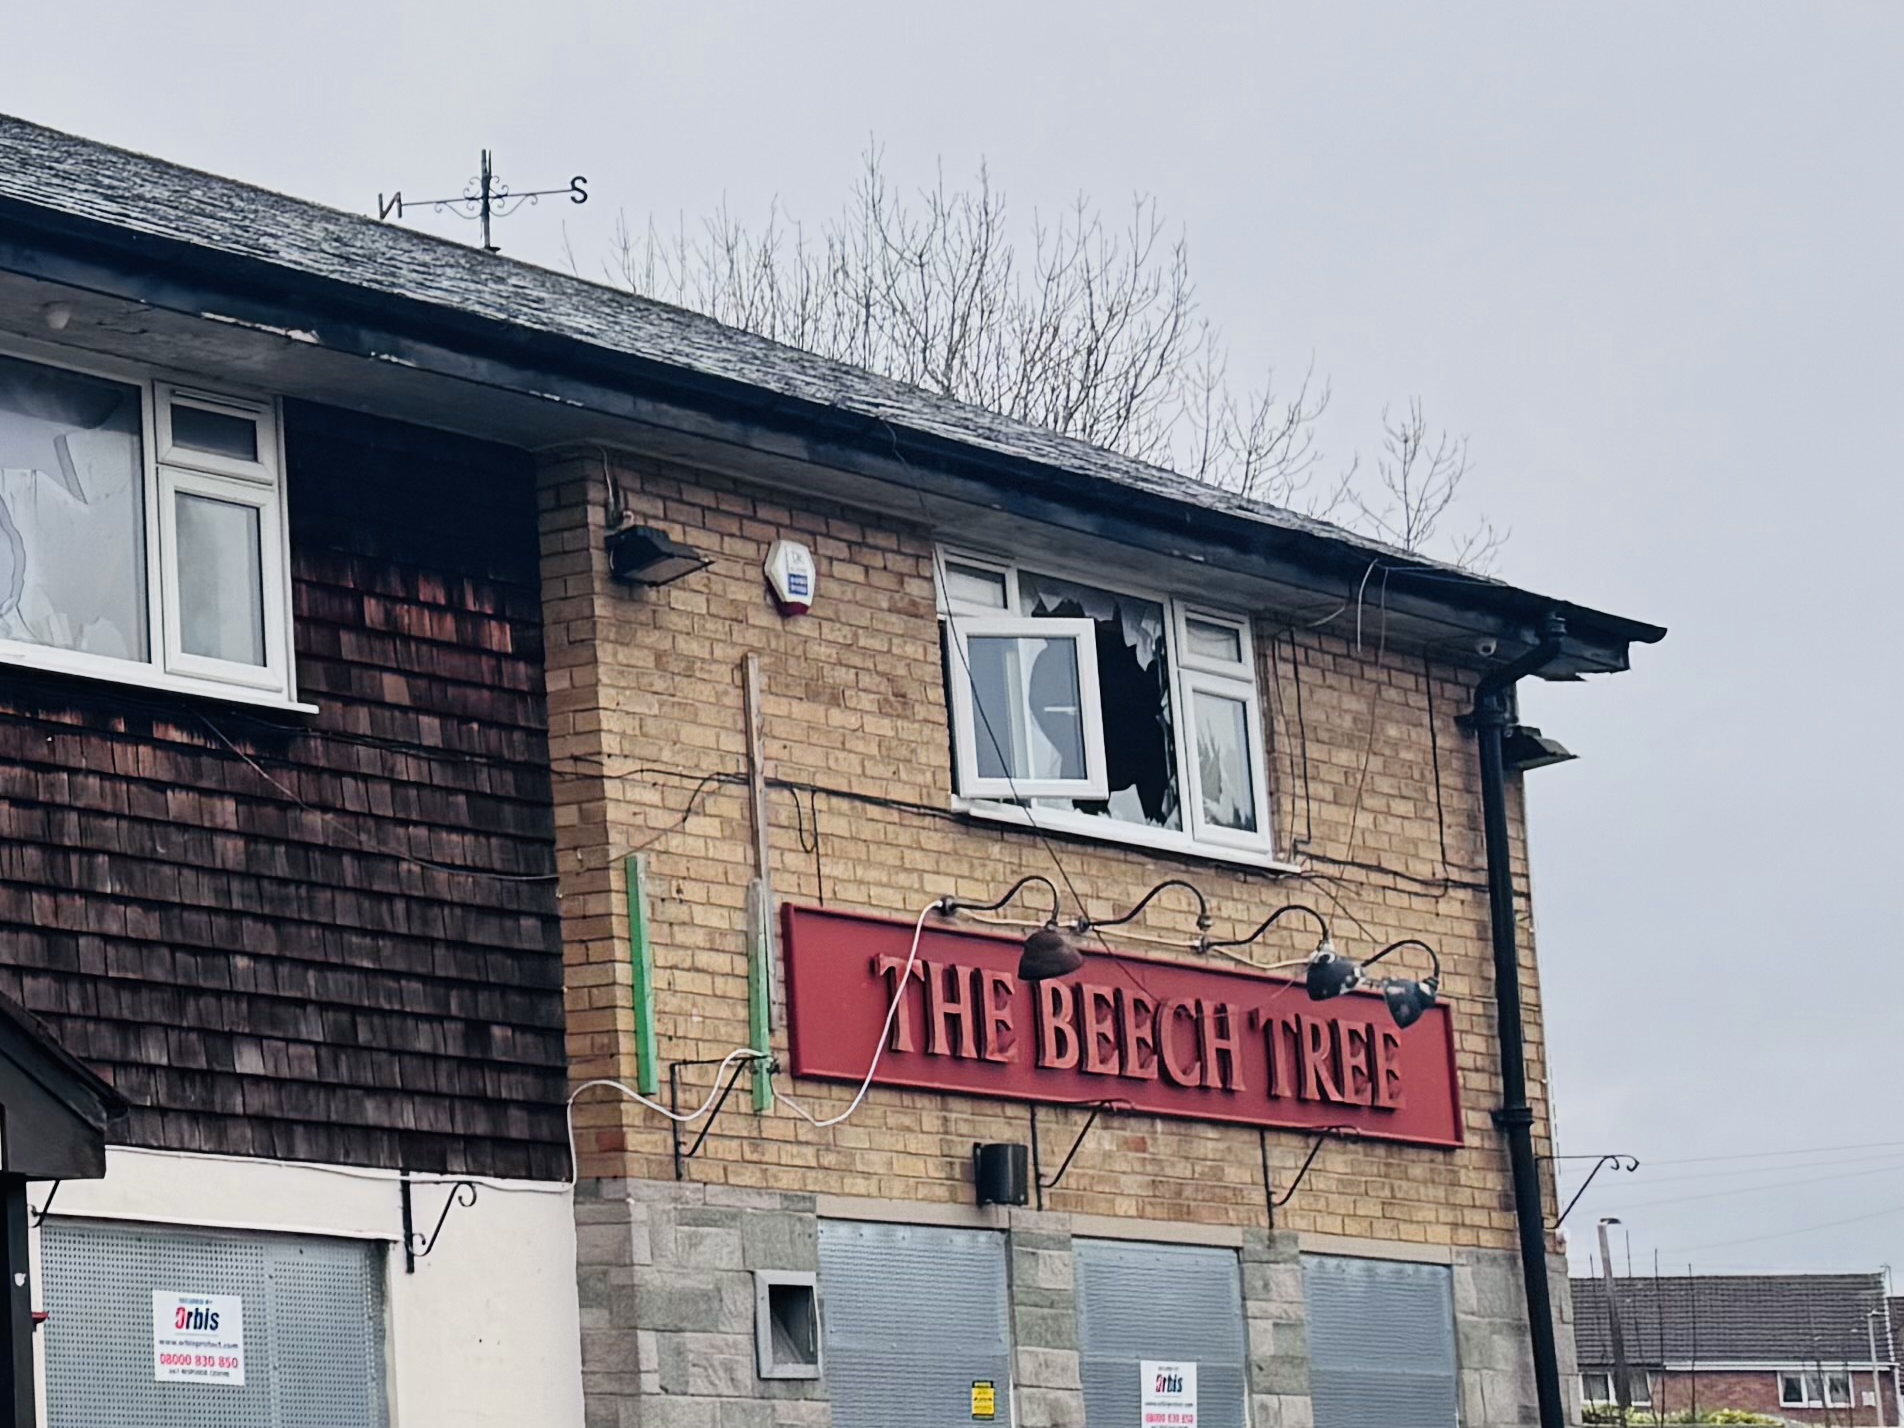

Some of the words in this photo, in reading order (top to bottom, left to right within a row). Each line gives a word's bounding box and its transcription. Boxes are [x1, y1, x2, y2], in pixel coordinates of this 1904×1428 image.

[874, 952, 1018, 1063] THE
[1037, 978, 1247, 1092] BEECH
[1257, 1008, 1406, 1110] TREE
[175, 1306, 219, 1331] Orbis
[159, 1353, 192, 1366] 08000
[194, 1354, 215, 1368] 830
[218, 1355, 239, 1369] 850
